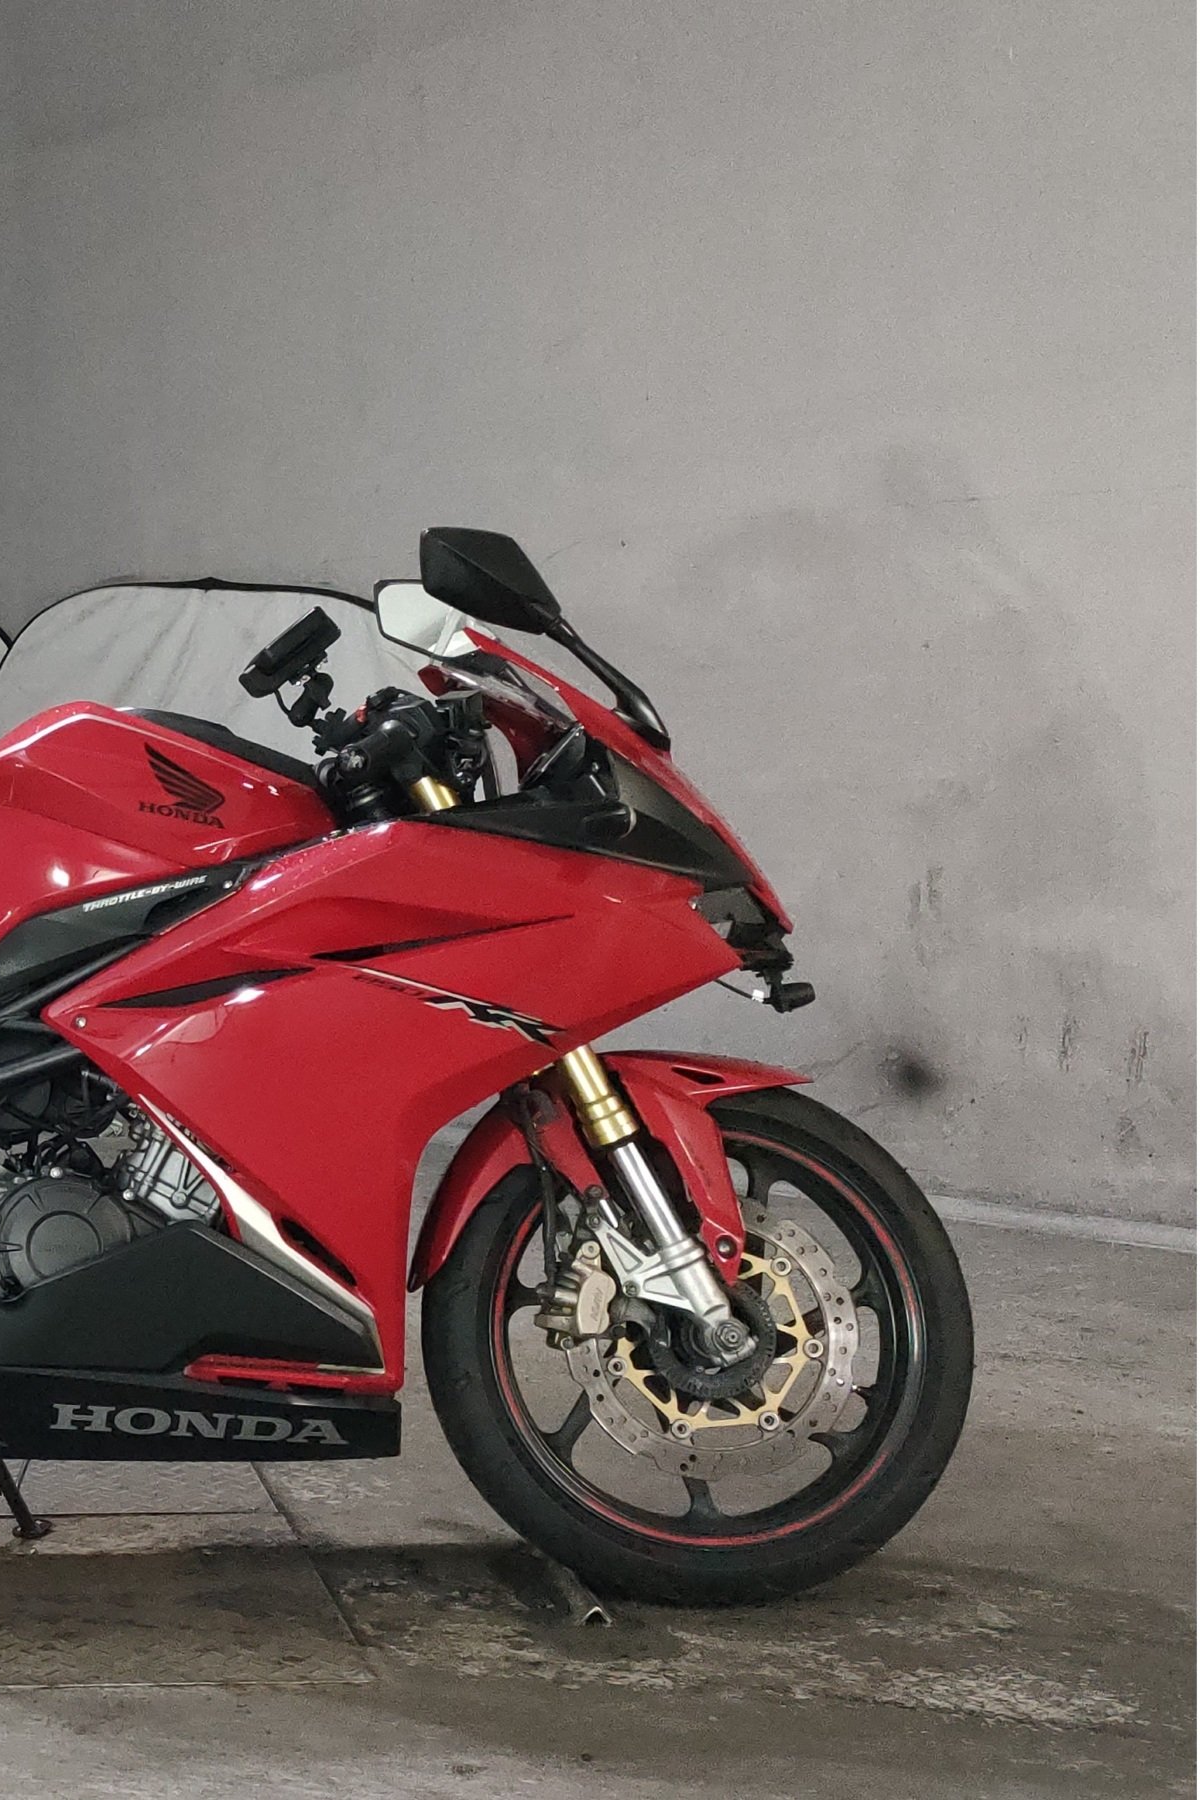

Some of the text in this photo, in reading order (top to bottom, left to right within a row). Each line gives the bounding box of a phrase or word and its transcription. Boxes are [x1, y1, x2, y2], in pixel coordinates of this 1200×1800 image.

[139, 802, 225, 829] HONDA
[83, 875, 208, 912] THROTTLE-BY-WIRE
[50, 1403, 349, 1445] HONDA
